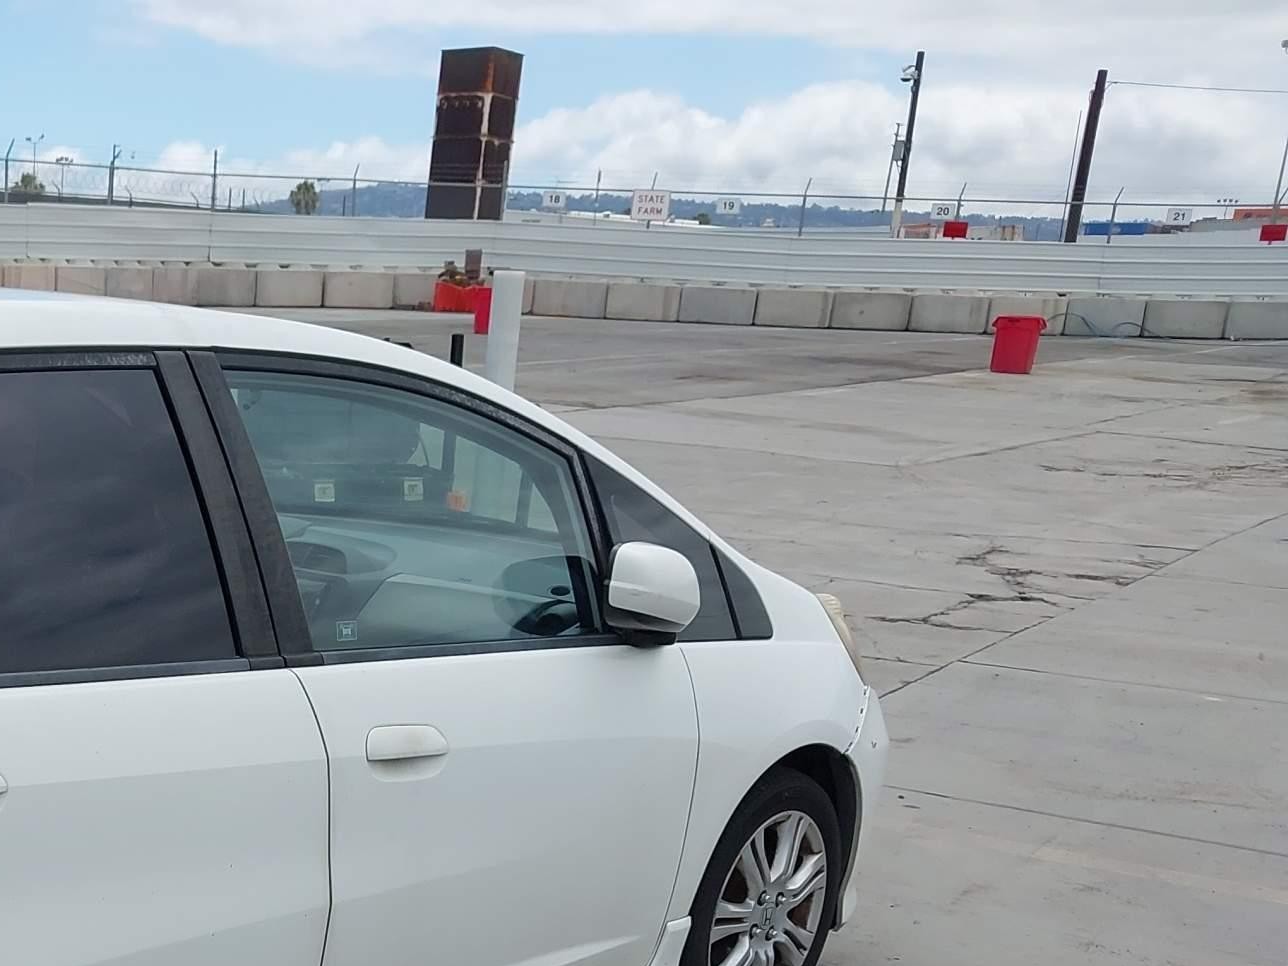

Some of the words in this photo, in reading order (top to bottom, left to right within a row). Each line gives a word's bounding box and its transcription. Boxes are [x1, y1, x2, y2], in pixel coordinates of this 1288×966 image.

[548, 194, 561, 205] 18
[637, 194, 666, 205] STATE
[637, 206, 664, 216] FARM
[721, 201, 735, 211] 19
[936, 206, 950, 216] 20
[1173, 211, 1186, 221] 21
